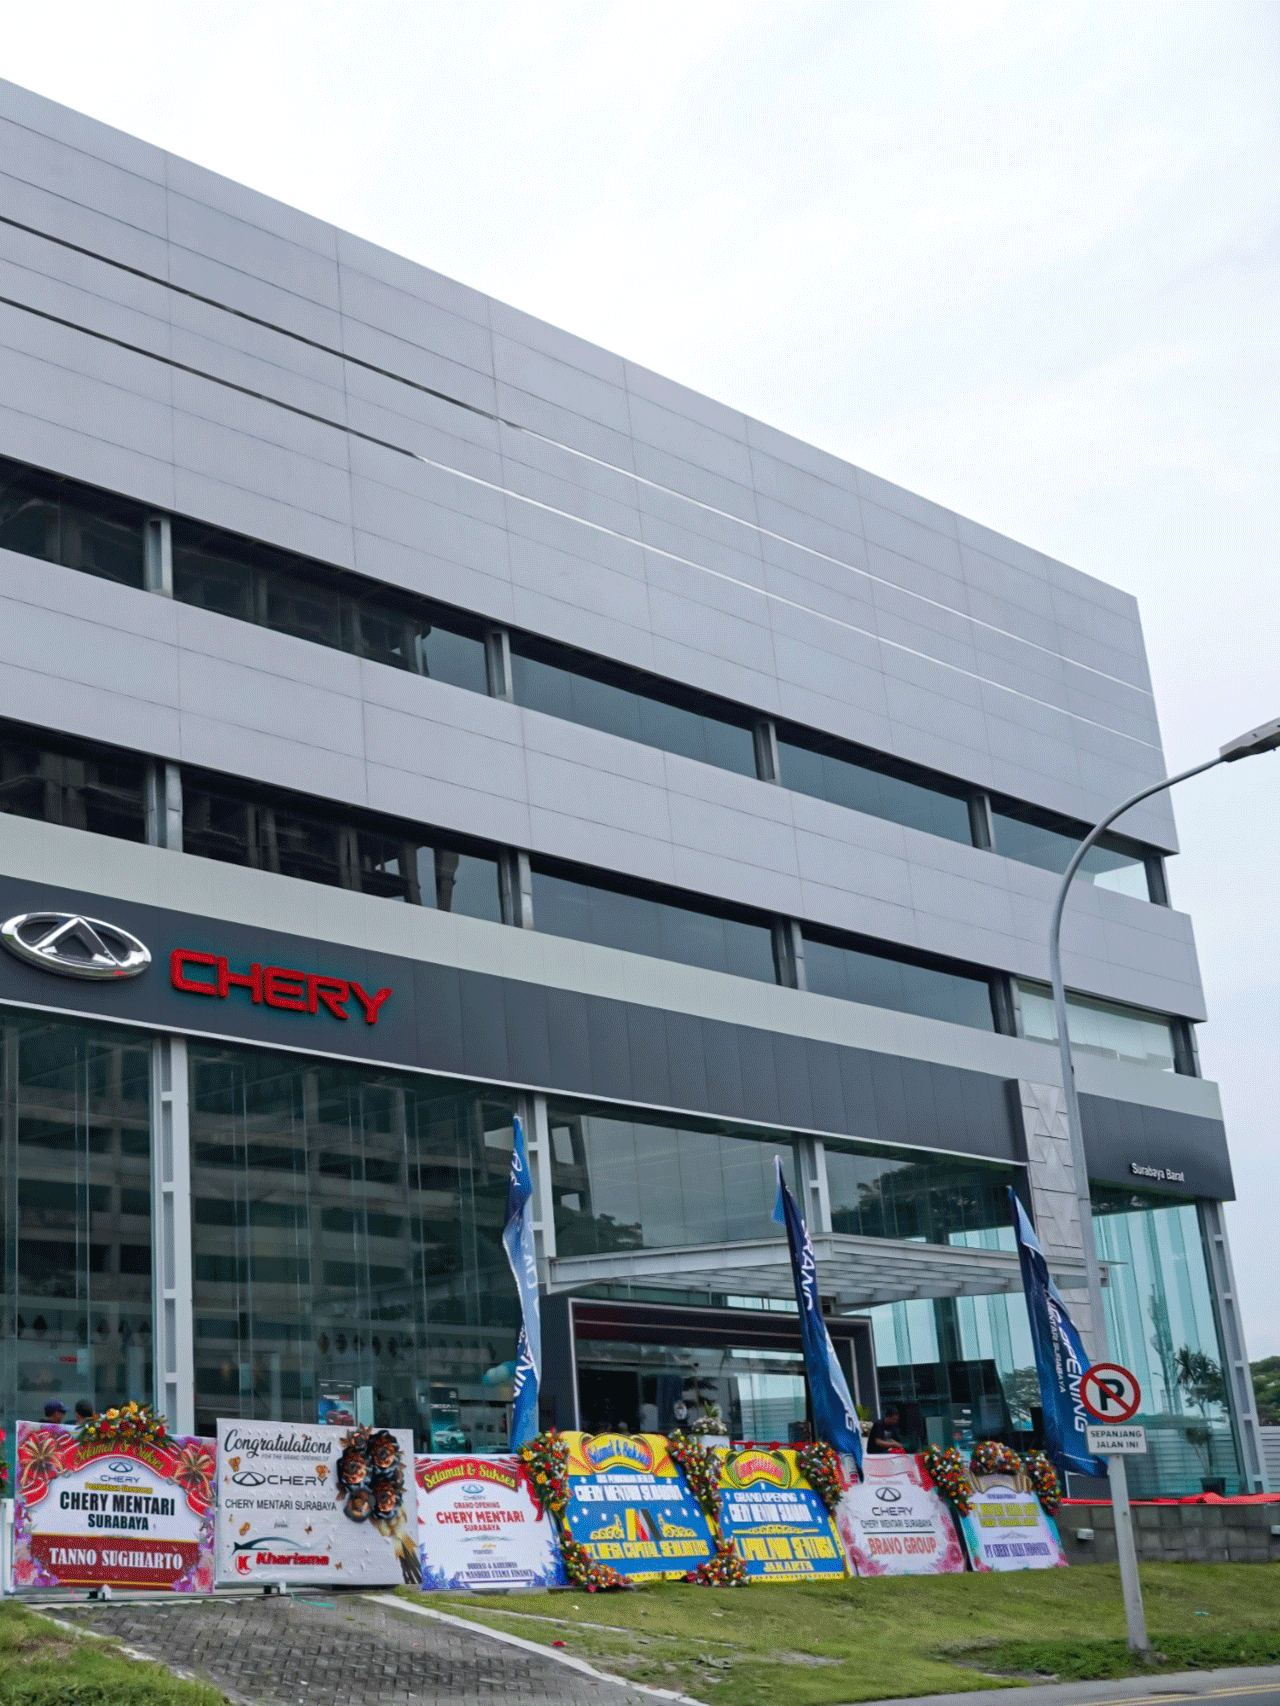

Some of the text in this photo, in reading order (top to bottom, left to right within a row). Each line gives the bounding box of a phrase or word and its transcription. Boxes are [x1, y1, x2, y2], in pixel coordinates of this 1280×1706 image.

[169, 948, 394, 1024] CHERY
[1130, 1162, 1185, 1182] Surabaya Barat
[1052, 1341, 1067, 1393] SURABAYA
[1090, 1430, 1142, 1438] SEPANJANG
[224, 1428, 332, 1460] Congratulations
[100, 1474, 141, 1484] CHERY
[267, 1474, 328, 1487] CHERY
[424, 1463, 516, 1488] Selamat & Sukses
[60, 1490, 176, 1516] CHERY MENTARI
[733, 1492, 798, 1503] GRAND OPENING
[225, 1498, 338, 1512] CHERY MENTARI SURABAYA
[453, 1501, 501, 1509] GRAND OPENING
[872, 1507, 913, 1516] CHERY
[88, 1513, 149, 1531] SURABAYA
[436, 1510, 526, 1525] CHERY MENTARI
[860, 1519, 933, 1529] CHERY MENTARI SURABAYA
[463, 1523, 502, 1532] SURABAYA
[867, 1536, 937, 1555] BRAVO GROUP
[49, 1547, 183, 1570] TANNO SUGIHARTO
[256, 1552, 329, 1566] Kharisma
[763, 1560, 814, 1573] JAKARTA
